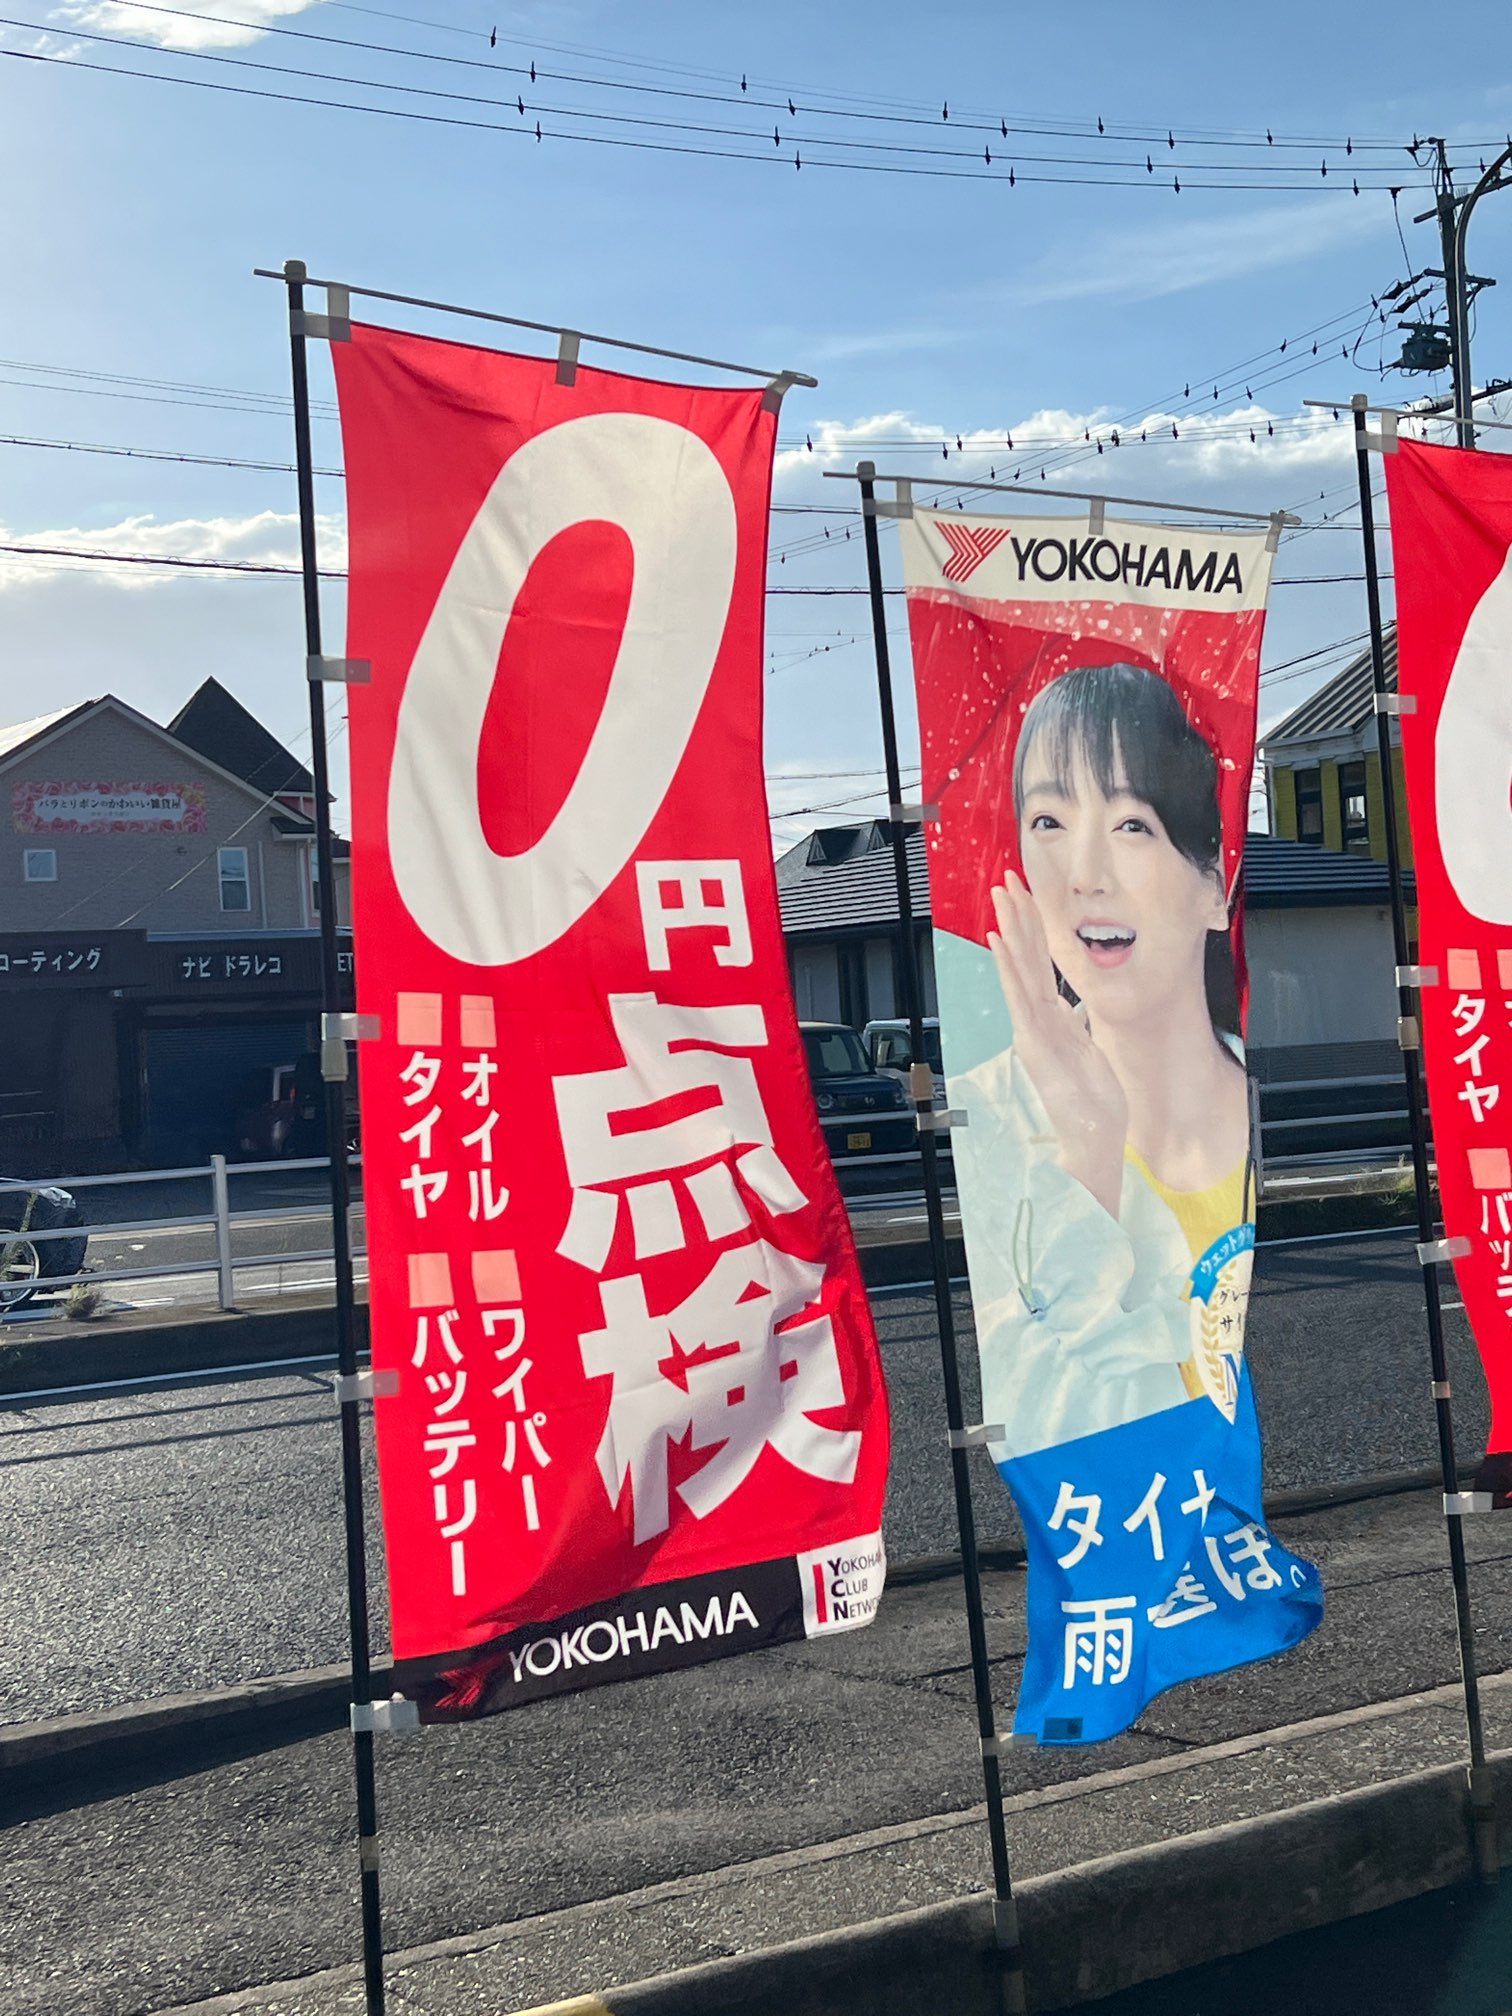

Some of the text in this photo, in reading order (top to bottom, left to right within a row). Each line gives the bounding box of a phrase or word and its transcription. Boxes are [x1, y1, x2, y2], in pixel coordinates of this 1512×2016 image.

[1011, 536, 1243, 594] YOKOHAMA
[388, 412, 737, 966] 0
[0, 948, 101, 972] コーティング
[225, 954, 281, 977] ドラレコ
[1451, 993, 1500, 1123] タイヤ
[399, 1051, 449, 1219] タイヤ
[460, 1053, 510, 1222] オイル
[411, 1309, 477, 1596] バッテリー
[479, 1308, 552, 1531] ワイパー
[507, 1591, 760, 1683] YOKOHAMA
